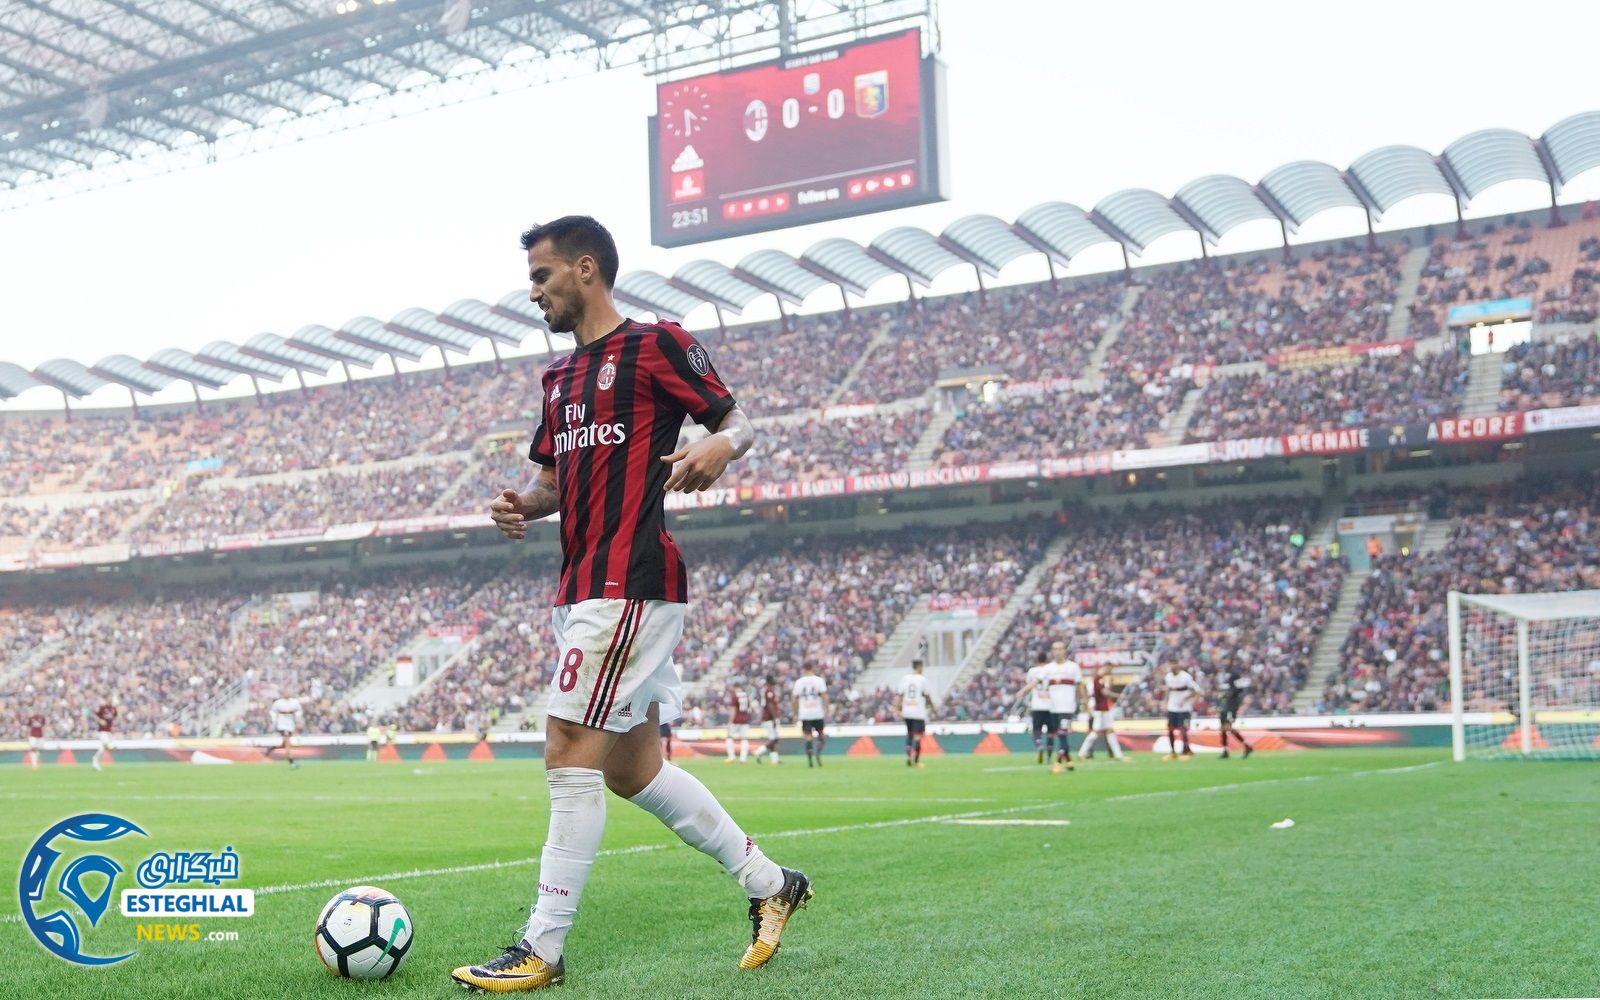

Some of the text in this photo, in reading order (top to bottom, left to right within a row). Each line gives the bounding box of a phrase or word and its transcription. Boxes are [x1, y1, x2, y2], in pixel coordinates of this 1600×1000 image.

[782, 97, 800, 129] 0
[827, 88, 845, 119] 0
[672, 207, 708, 228] 23:51
[565, 403, 586, 423] Fly
[553, 421, 626, 457] mirates
[1287, 428, 1370, 453] BERNATE
[1427, 415, 1516, 442] ARCORE
[559, 648, 583, 692] 8
